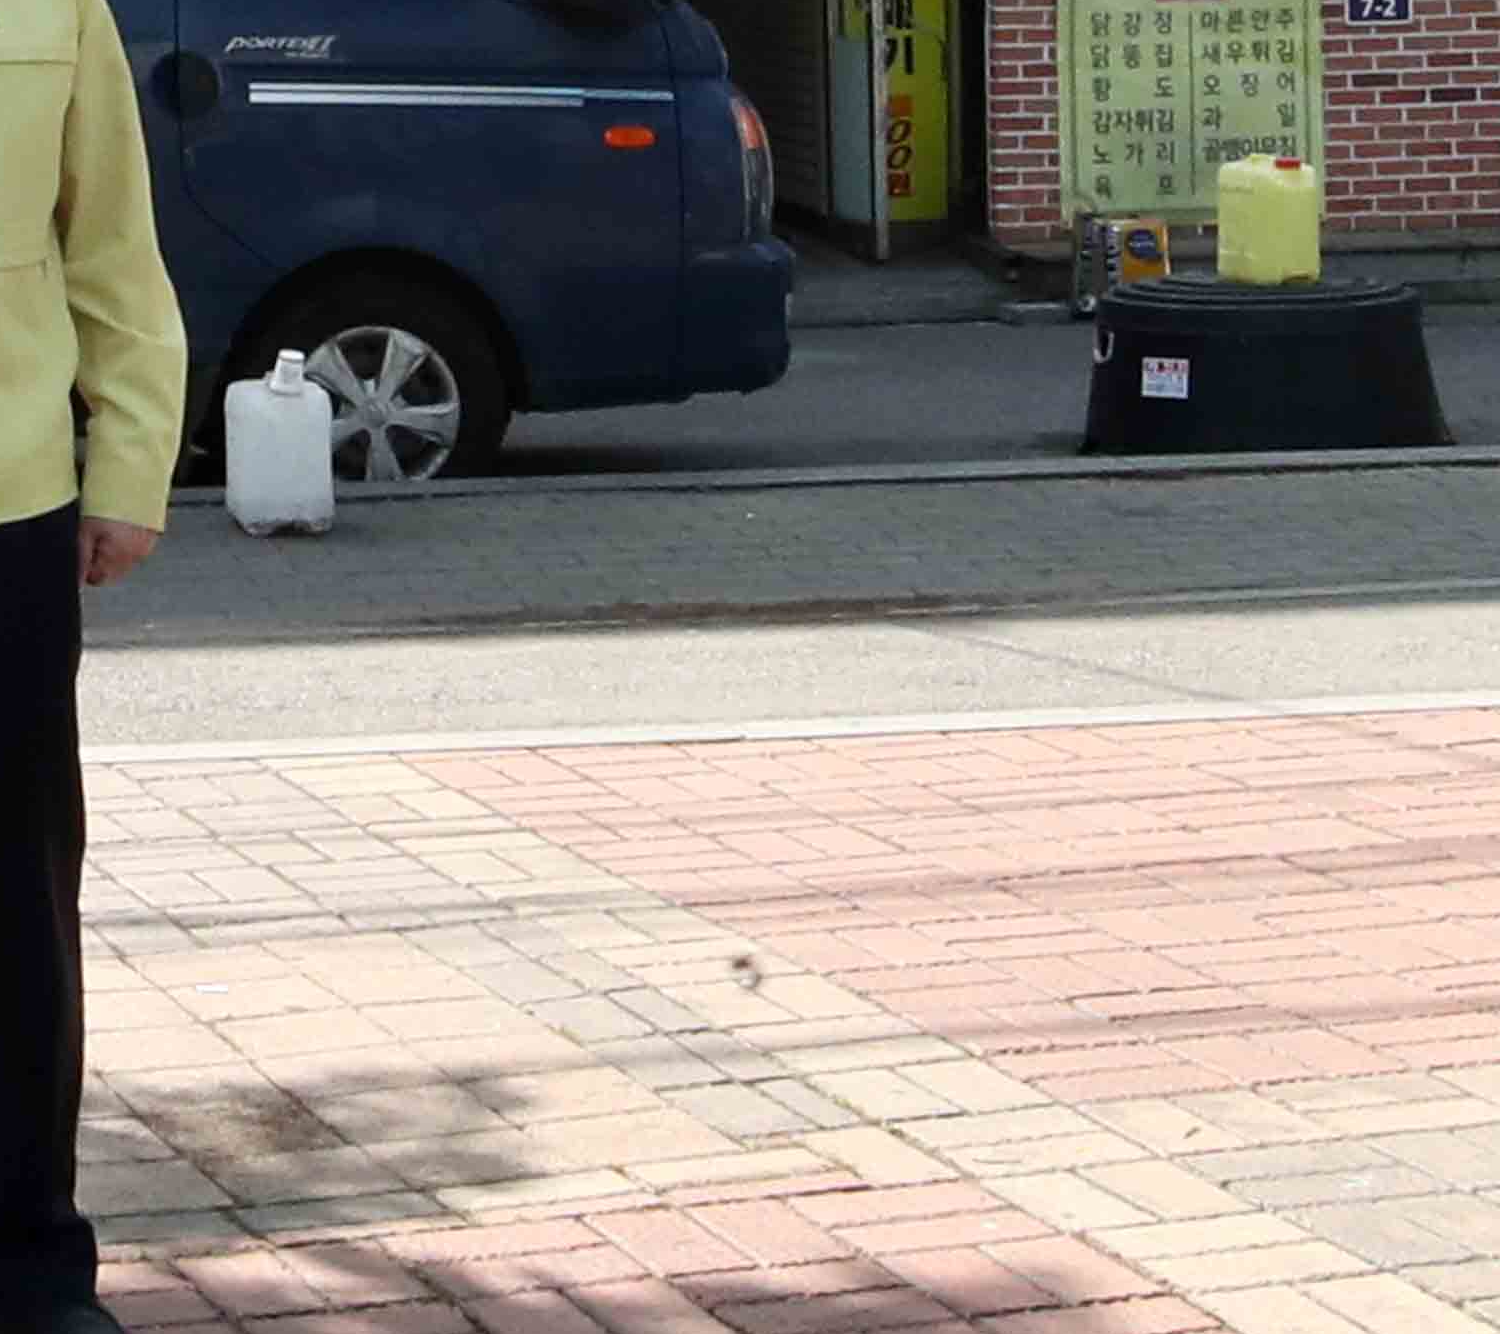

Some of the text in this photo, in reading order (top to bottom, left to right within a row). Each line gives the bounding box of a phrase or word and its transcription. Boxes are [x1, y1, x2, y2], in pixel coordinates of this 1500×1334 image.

[1201, 8, 1296, 34] 마른안주
[1202, 40, 1296, 65] 새우튀김
[1202, 71, 1296, 97] 오징어
[1092, 107, 1175, 134] 감자튀김
[1092, 140, 1176, 166] 노가리
